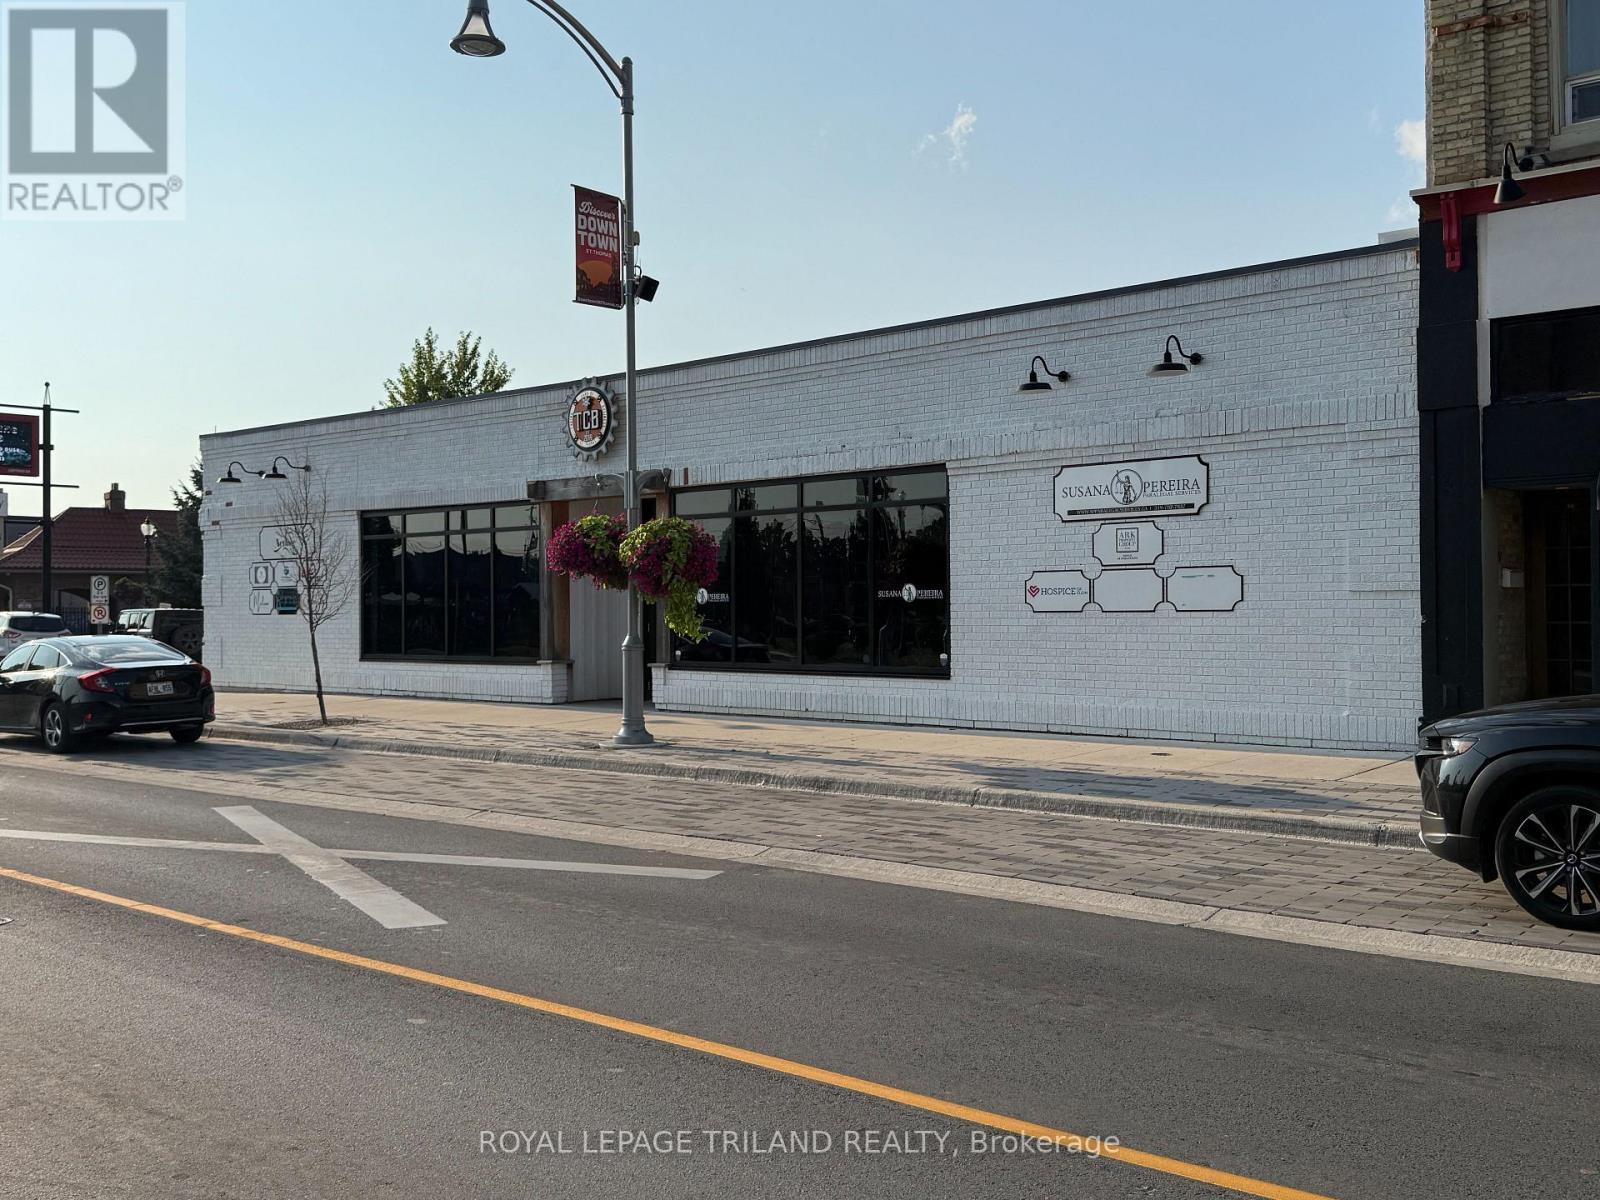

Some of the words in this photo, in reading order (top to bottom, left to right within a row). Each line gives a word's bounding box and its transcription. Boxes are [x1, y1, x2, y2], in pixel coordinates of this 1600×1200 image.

[579, 201, 616, 220] Discover
[577, 214, 618, 237] DOWN
[577, 230, 618, 252] TOWN
[573, 410, 598, 431] TCB
[1062, 484, 1111, 498] SUSANA
[1143, 478, 1201, 493] PEREIRA
[1119, 530, 1136, 539] ARK
[877, 590, 902, 598] SUSANA
[1040, 587, 1077, 596] HOSPICE
